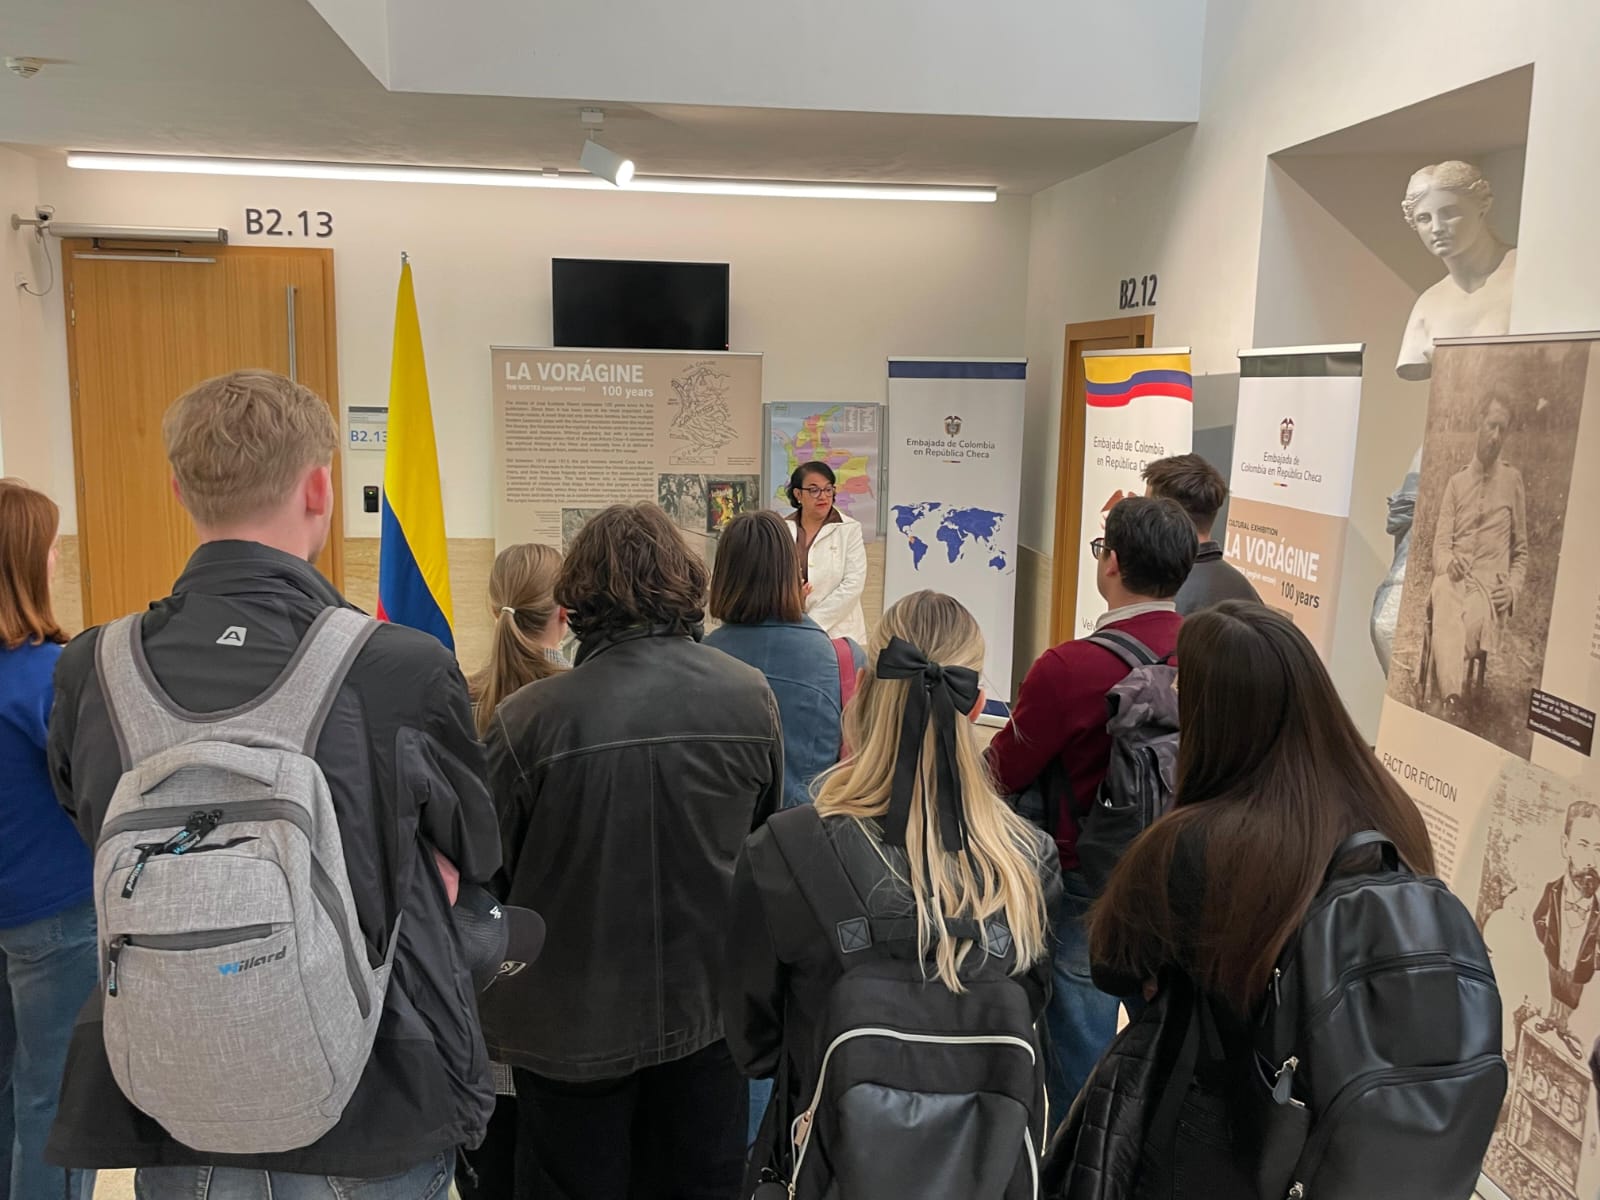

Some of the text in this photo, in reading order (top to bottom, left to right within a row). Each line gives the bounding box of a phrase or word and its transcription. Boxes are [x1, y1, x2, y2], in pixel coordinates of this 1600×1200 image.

[245, 208, 333, 237] B2.13
[1119, 274, 1158, 310] B2.12
[504, 359, 643, 382] LA VORÁGINE
[602, 386, 654, 398] 100 years
[906, 439, 945, 447] Embajada
[958, 440, 995, 449] Colombia
[925, 448, 964, 457] República
[966, 450, 990, 458] Checa
[1093, 435, 1164, 455] Embajada de Colombia
[1096, 457, 1104, 466] en
[1105, 456, 1138, 471] República
[1263, 452, 1300, 465] Embajada de
[1240, 462, 1267, 475] Colombia
[1267, 467, 1276, 476] en
[1303, 470, 1322, 483] Checa
[1223, 531, 1241, 561] LA
[1245, 536, 1320, 584] VORÁGINE
[1281, 581, 1320, 609] 100 years
[1383, 752, 1458, 803] FACT OR FICTION
[216, 945, 287, 976] Willard
